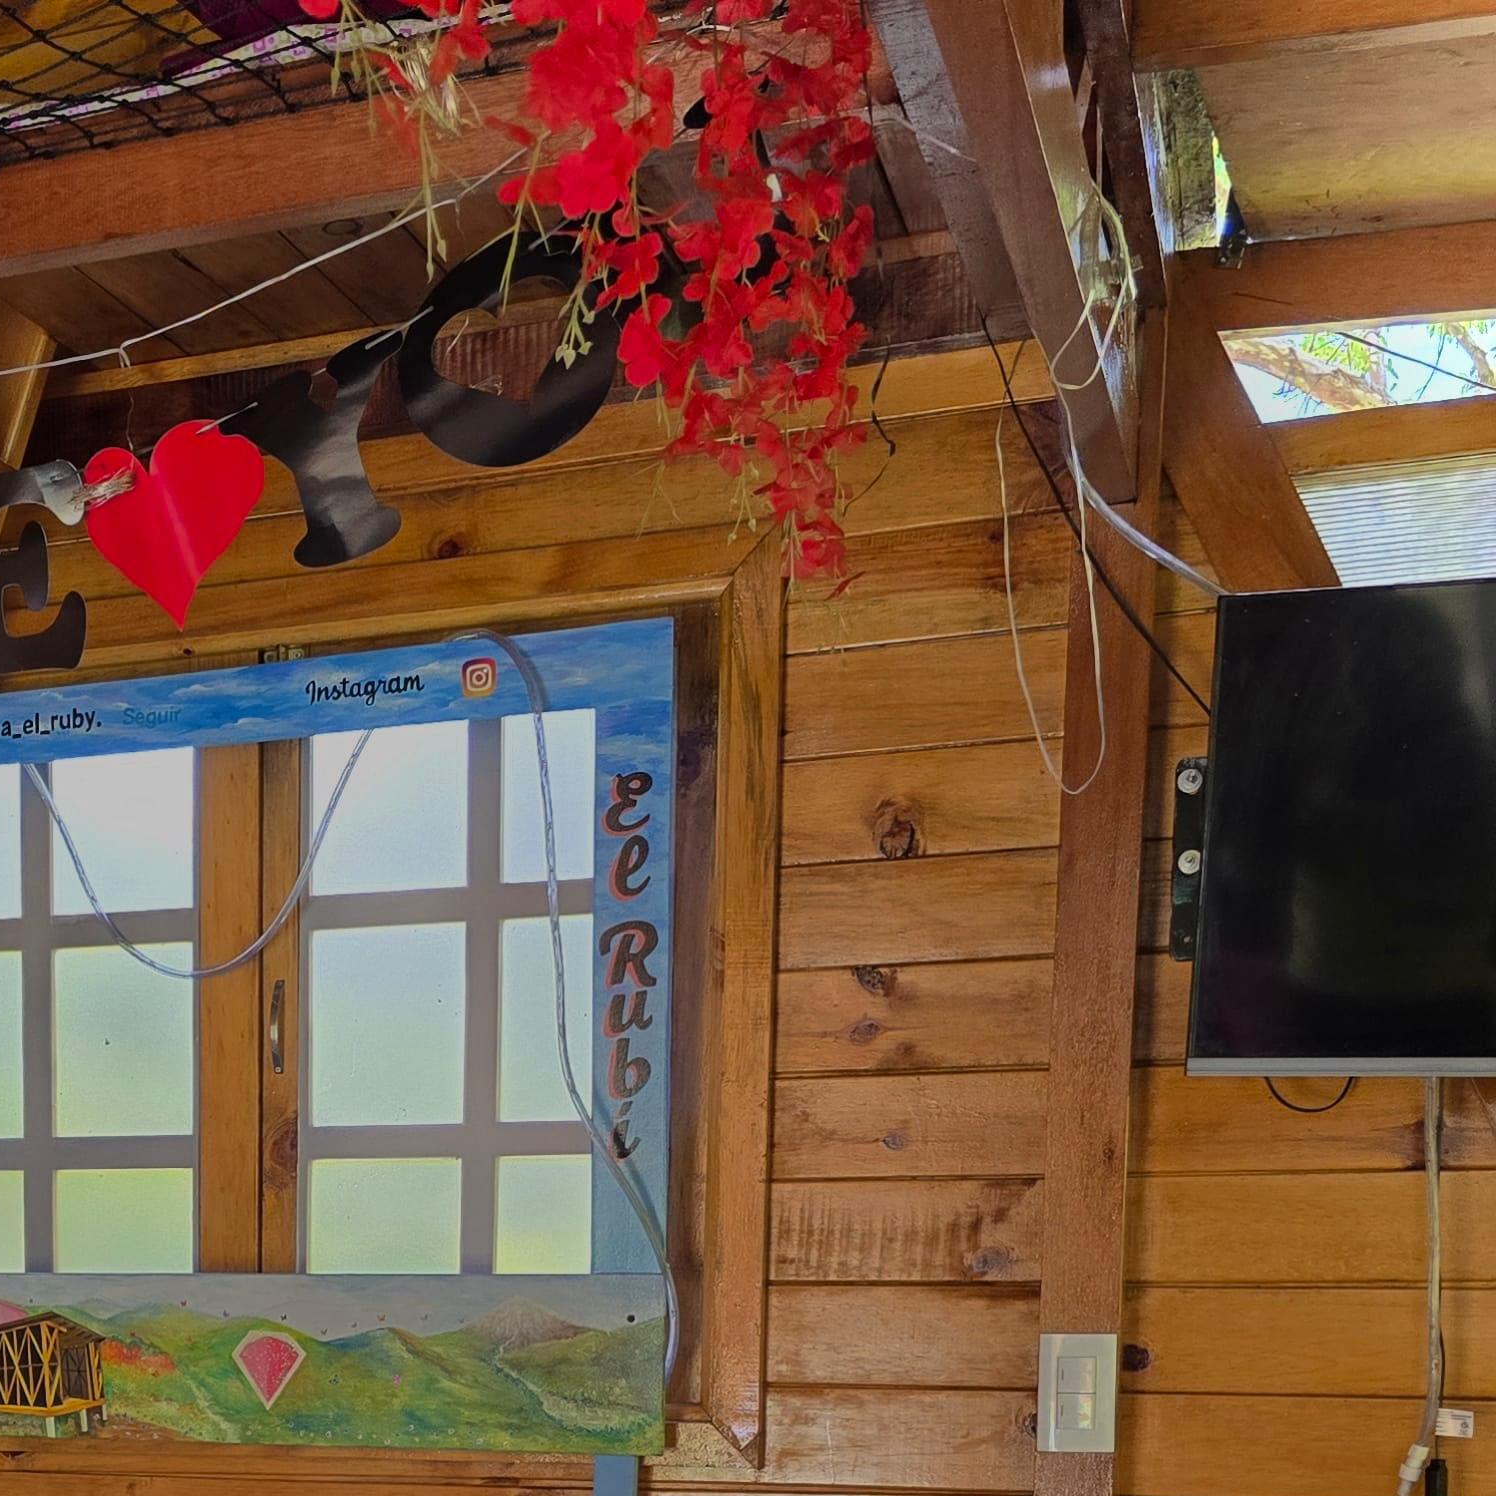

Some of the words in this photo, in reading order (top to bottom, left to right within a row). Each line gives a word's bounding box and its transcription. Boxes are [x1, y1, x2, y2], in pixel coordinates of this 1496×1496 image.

[219, 225, 704, 567] YO
[305, 671, 426, 706] Instagram
[123, 705, 183, 728] Seguir
